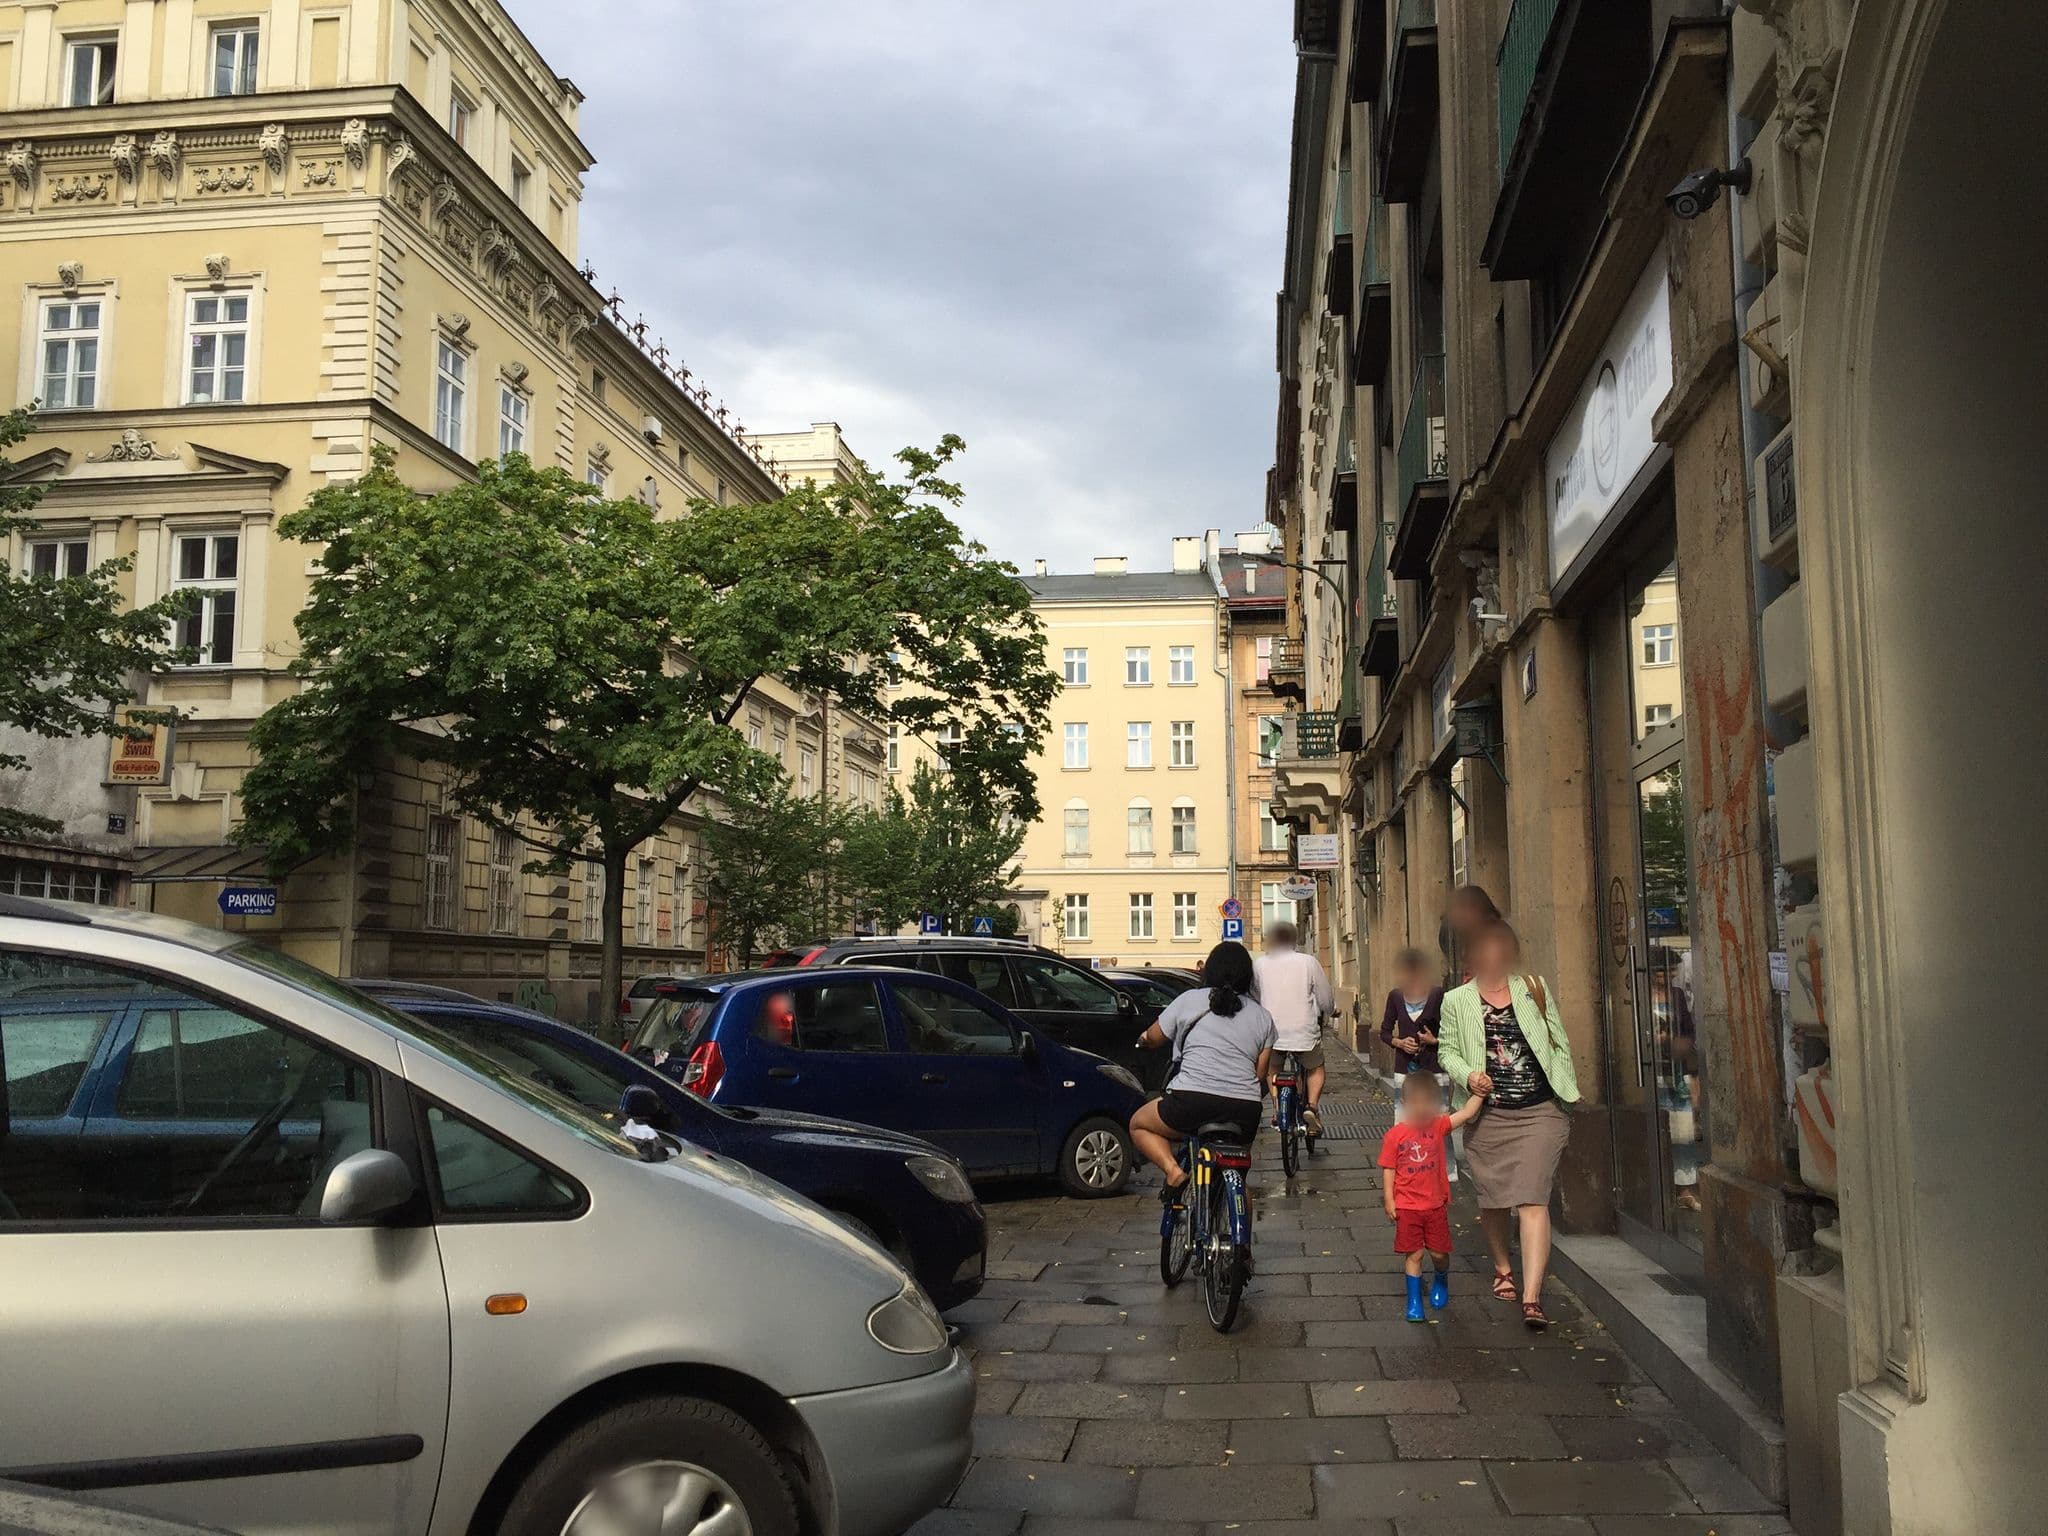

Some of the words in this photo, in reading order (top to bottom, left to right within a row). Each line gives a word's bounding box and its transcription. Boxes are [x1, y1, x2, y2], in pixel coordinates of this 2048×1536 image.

[1624, 322, 1657, 420] Club
[228, 894, 276, 907] PARKING
[926, 915, 938, 931] P
[1227, 920, 1240, 937] P
